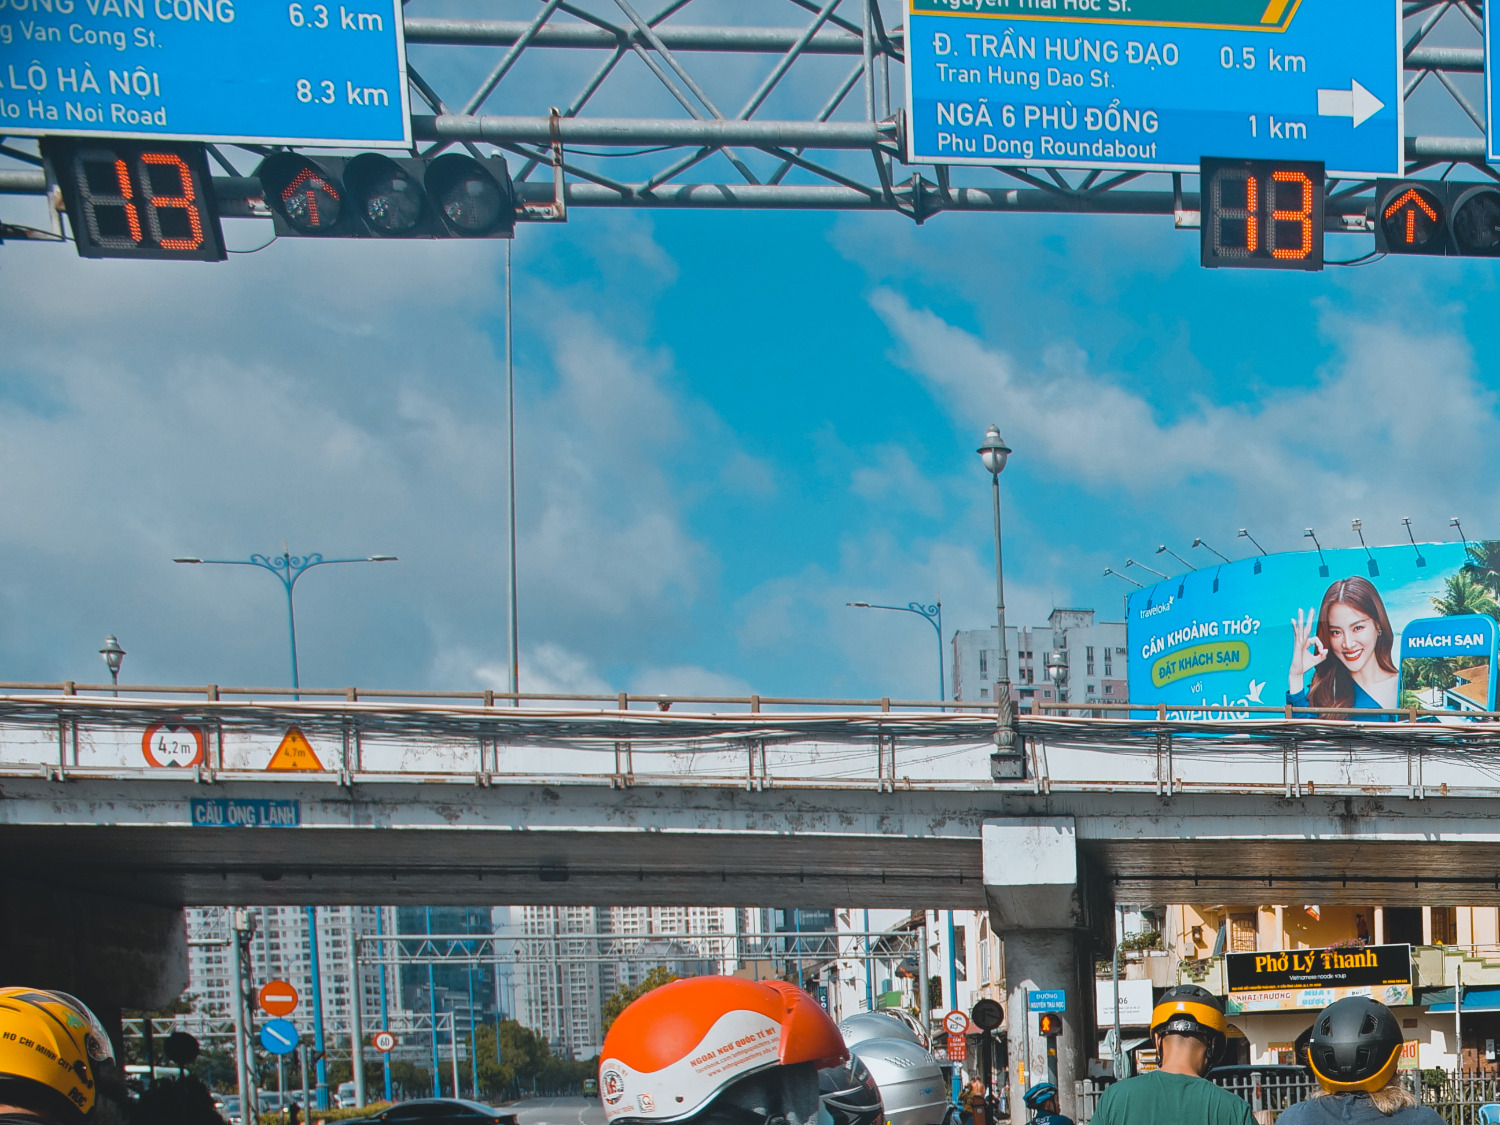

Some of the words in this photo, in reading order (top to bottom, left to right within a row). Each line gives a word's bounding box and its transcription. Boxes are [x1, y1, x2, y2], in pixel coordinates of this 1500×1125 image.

[289, 3, 330, 29] 6.3
[340, 11, 383, 32] km
[19, 20, 61, 41] Van
[69, 23, 126, 51] Cong
[133, 27, 163, 49] St.
[932, 32, 959, 57] Đ.
[965, 27, 1036, 59] TRẦN
[1045, 35, 1119, 64] HƯNG
[1125, 42, 1180, 70] ĐẠO
[1220, 46, 1257, 71] 0.5
[1268, 48, 1307, 73] km
[8, 59, 47, 95] LỘ
[57, 61, 101, 94] HÀ
[108, 65, 161, 101] NỘI
[936, 63, 982, 84] Tran
[988, 66, 1041, 90] Hung
[1048, 68, 1084, 88] Dao
[1089, 69, 1115, 89] St.
[296, 79, 336, 104] 8.3
[346, 82, 389, 107] km
[28, 99, 58, 121] Ha
[65, 101, 104, 123] Noi
[111, 103, 167, 126] Road
[936, 97, 993, 129] NGÃ
[1002, 104, 1015, 129] 6
[1024, 100, 1078, 131] PHÙ
[1084, 99, 1160, 134] ĐỔNG
[1249, 115, 1257, 138] 1
[1269, 115, 1308, 139] km
[937, 132, 978, 153] Phu
[983, 134, 1034, 160] Dong
[1041, 136, 1158, 160] Roundabout
[1140, 601, 1171, 619] traveloka
[1142, 635, 1165, 659] CẦN
[1167, 620, 1219, 648] KHOẢNG
[1222, 614, 1261, 635] THỞ?
[1408, 633, 1452, 648] KHÁCH
[1454, 633, 1484, 648] SẠN
[1178, 651, 1214, 672] KHÁCH
[1216, 650, 1240, 667] SẠN
[1190, 681, 1203, 694] với
[194, 799, 223, 825] CẦU
[226, 804, 256, 825] ÔNG
[259, 803, 297, 825] LÃNH
[1255, 952, 1288, 973] Phở
[1293, 950, 1315, 973] Lý
[1320, 949, 1379, 970] Thanh
[19, 1036, 35, 1048] CHI
[36, 1044, 58, 1061] MINH
[380, 1035, 390, 1048] 60
